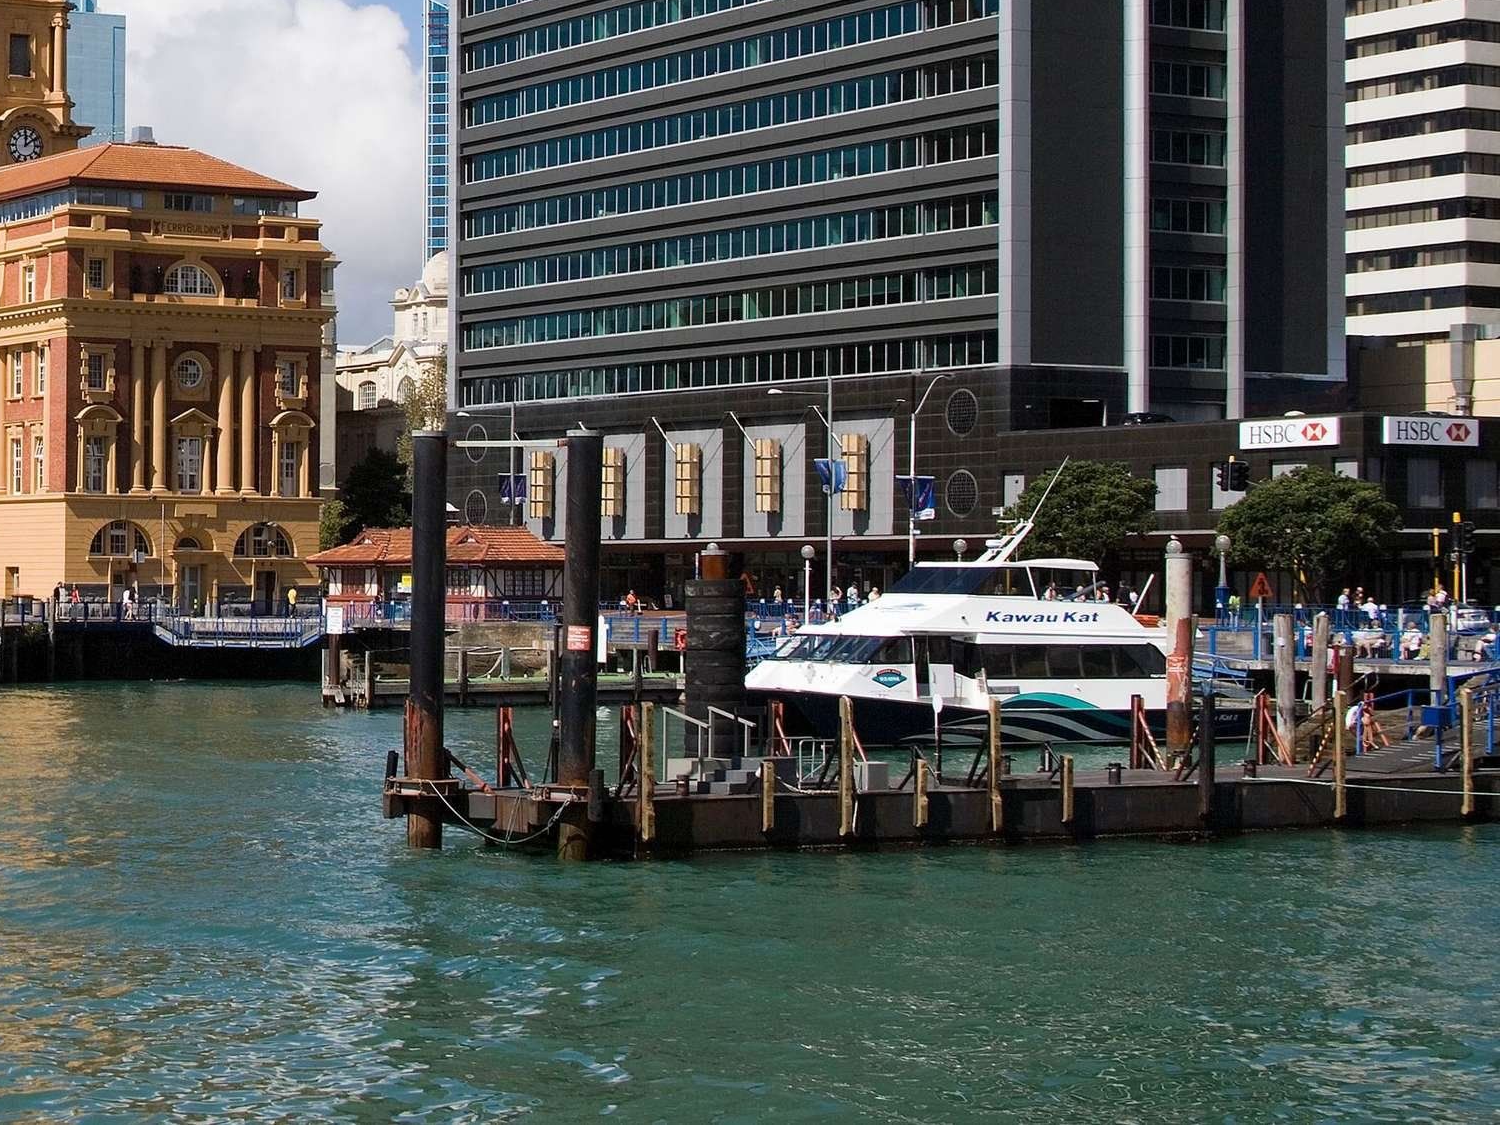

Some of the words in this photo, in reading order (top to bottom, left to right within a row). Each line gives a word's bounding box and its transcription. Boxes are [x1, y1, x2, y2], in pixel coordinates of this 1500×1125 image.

[1249, 423, 1296, 445] HSBC
[1396, 420, 1442, 442] HSBC
[985, 611, 1058, 623] Kawau
[1062, 611, 1099, 623] Kat
